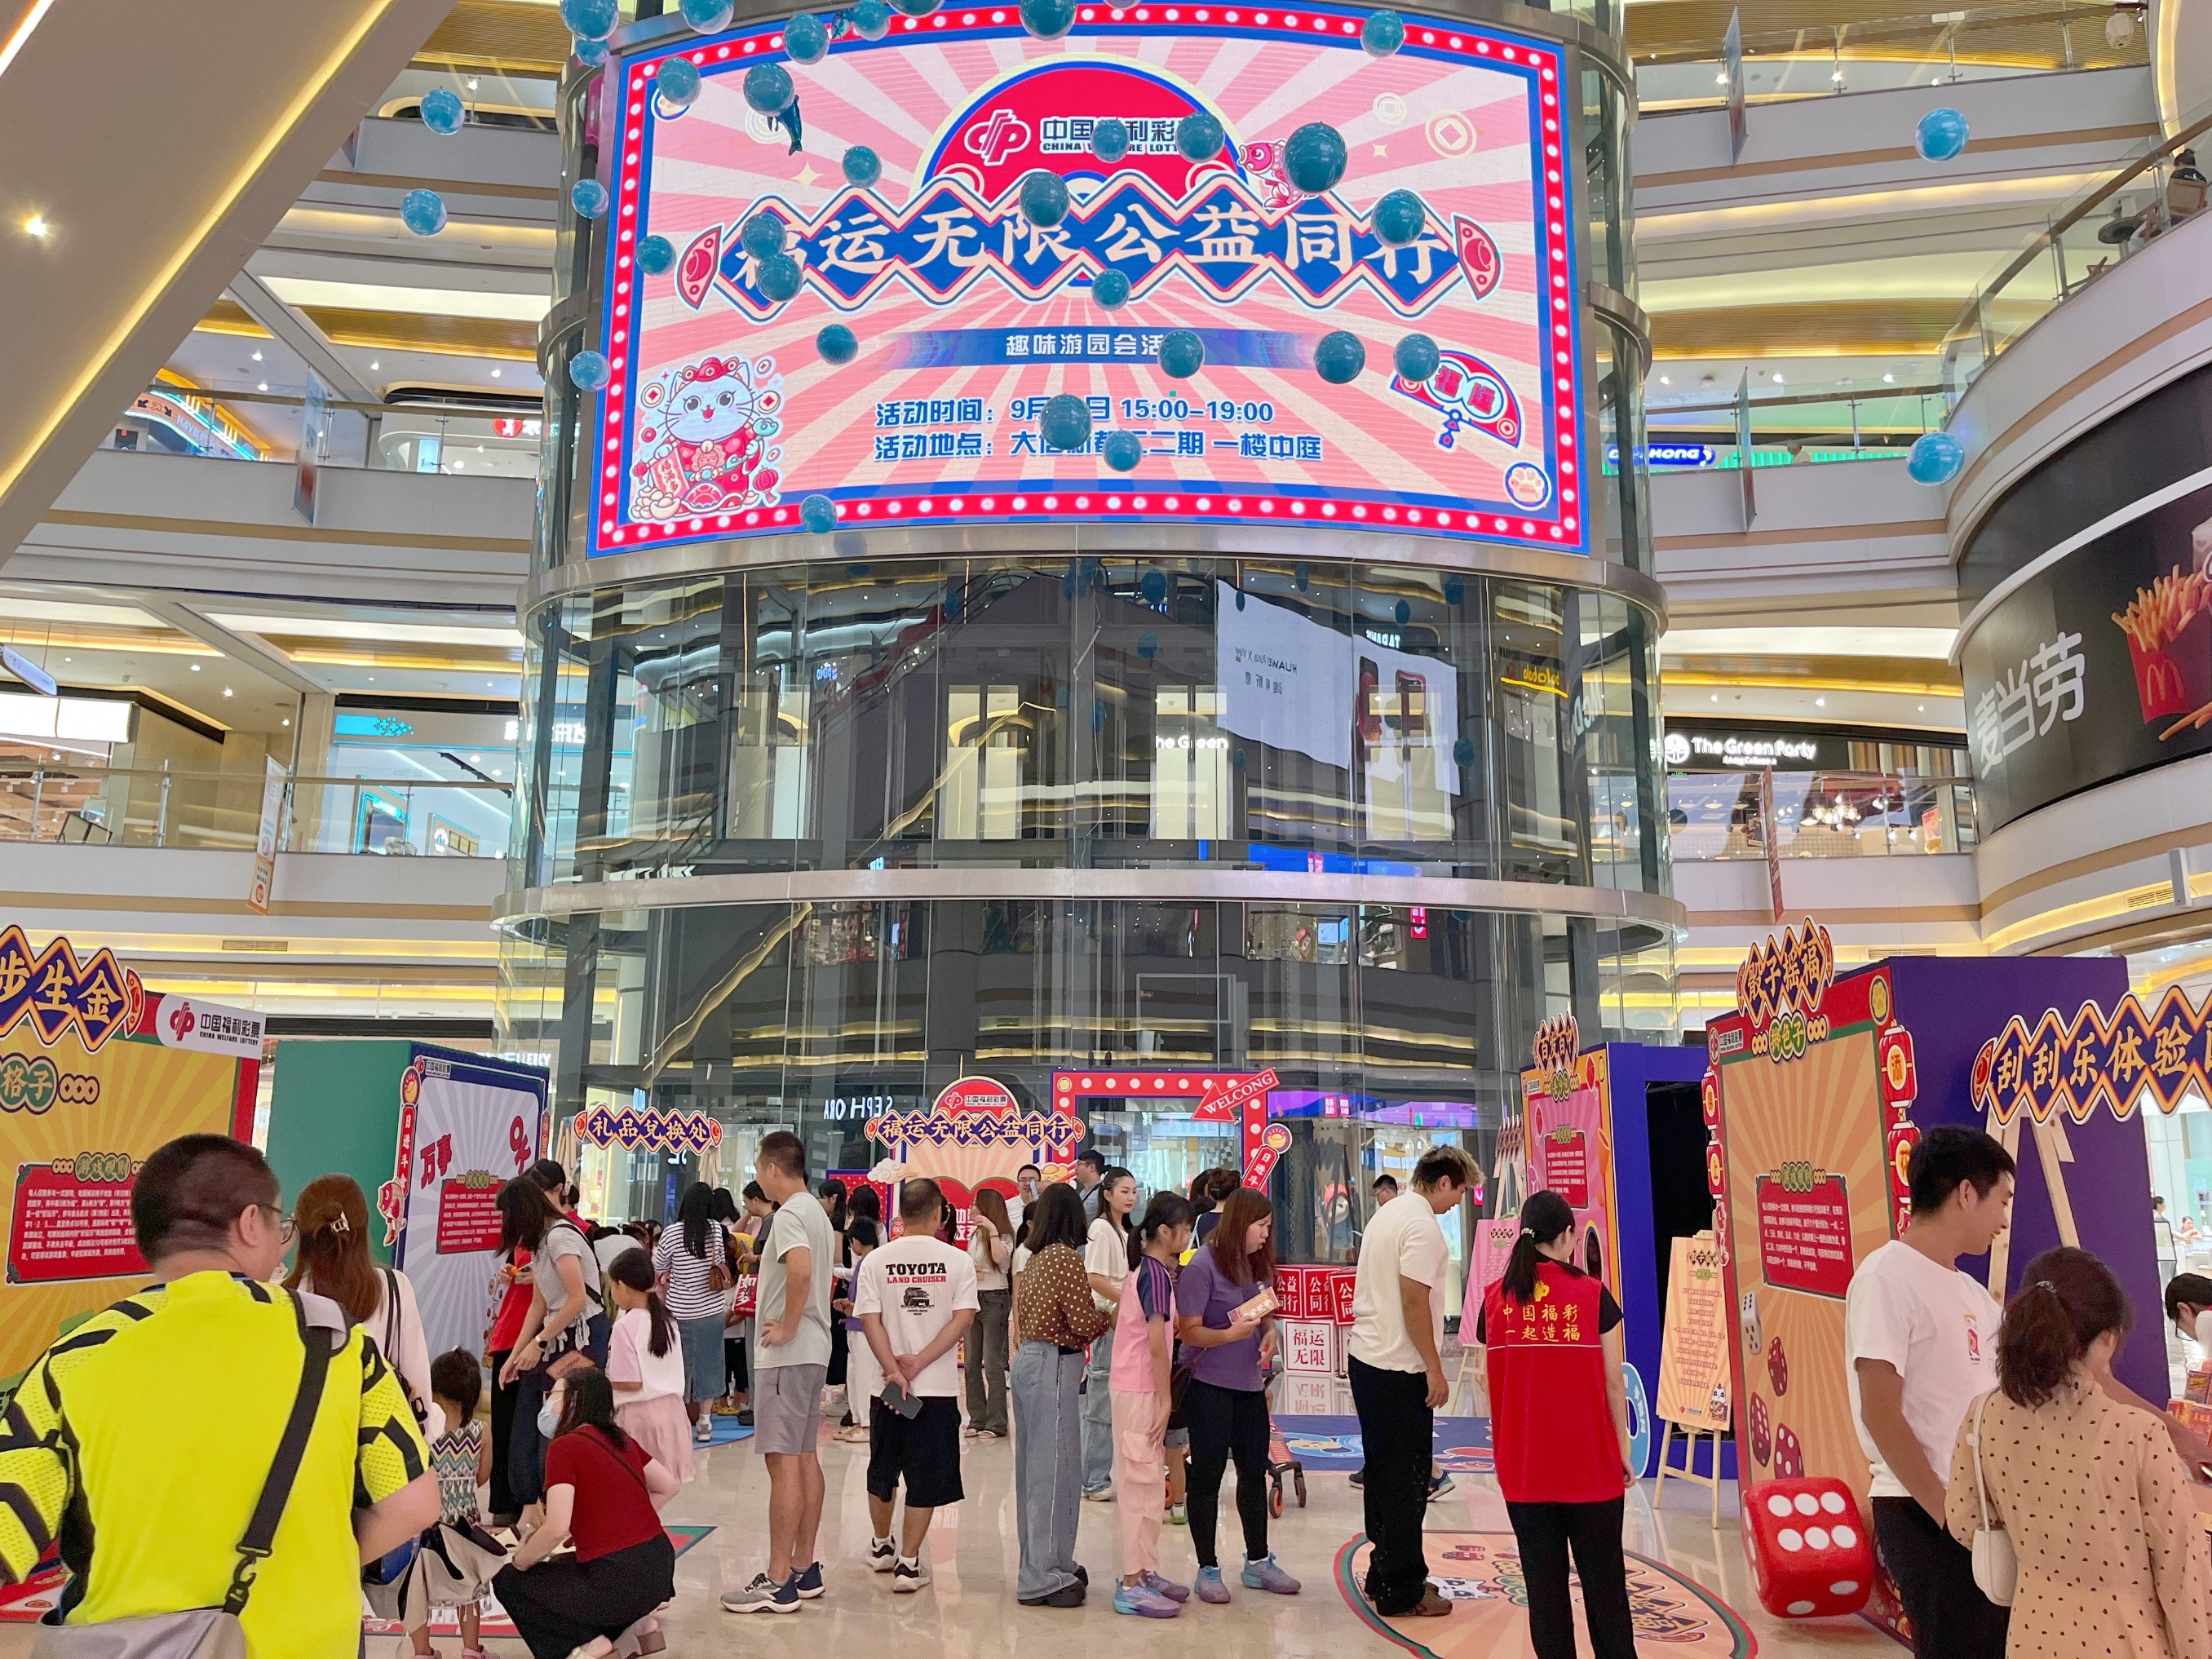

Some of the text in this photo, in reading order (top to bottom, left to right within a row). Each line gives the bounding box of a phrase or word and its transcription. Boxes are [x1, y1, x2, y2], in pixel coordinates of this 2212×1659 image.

[1042, 143, 1082, 151] CHINA
[1006, 334, 1165, 356] 趣味游园会活
[1213, 433, 1323, 461] 一楼中庭
[1975, 631, 2086, 780] 麦当劳
[1691, 737, 1817, 760] The Green Party
[1748, 939, 1820, 1002] 骰子摇福
[201, 1013, 261, 1039] 中国福利彩票
[199, 1031, 259, 1046] CHINA WELFARE LOTTERY
[1202, 1071, 1273, 1115] WELCONG
[592, 1117, 710, 1144] 礼品兑换处
[882, 1120, 1072, 1139] 福运无限公益同行
[420, 1133, 453, 1189] 万事
[885, 1263, 947, 1275] TOYOTA
[911, 1276, 947, 1284] CRUISER
[1502, 1303, 1579, 1323] 中国福彩
[1293, 1328, 1325, 1347] 福运
[1505, 1323, 1581, 1343] 一起造福
[1294, 1348, 1325, 1366] 无限
